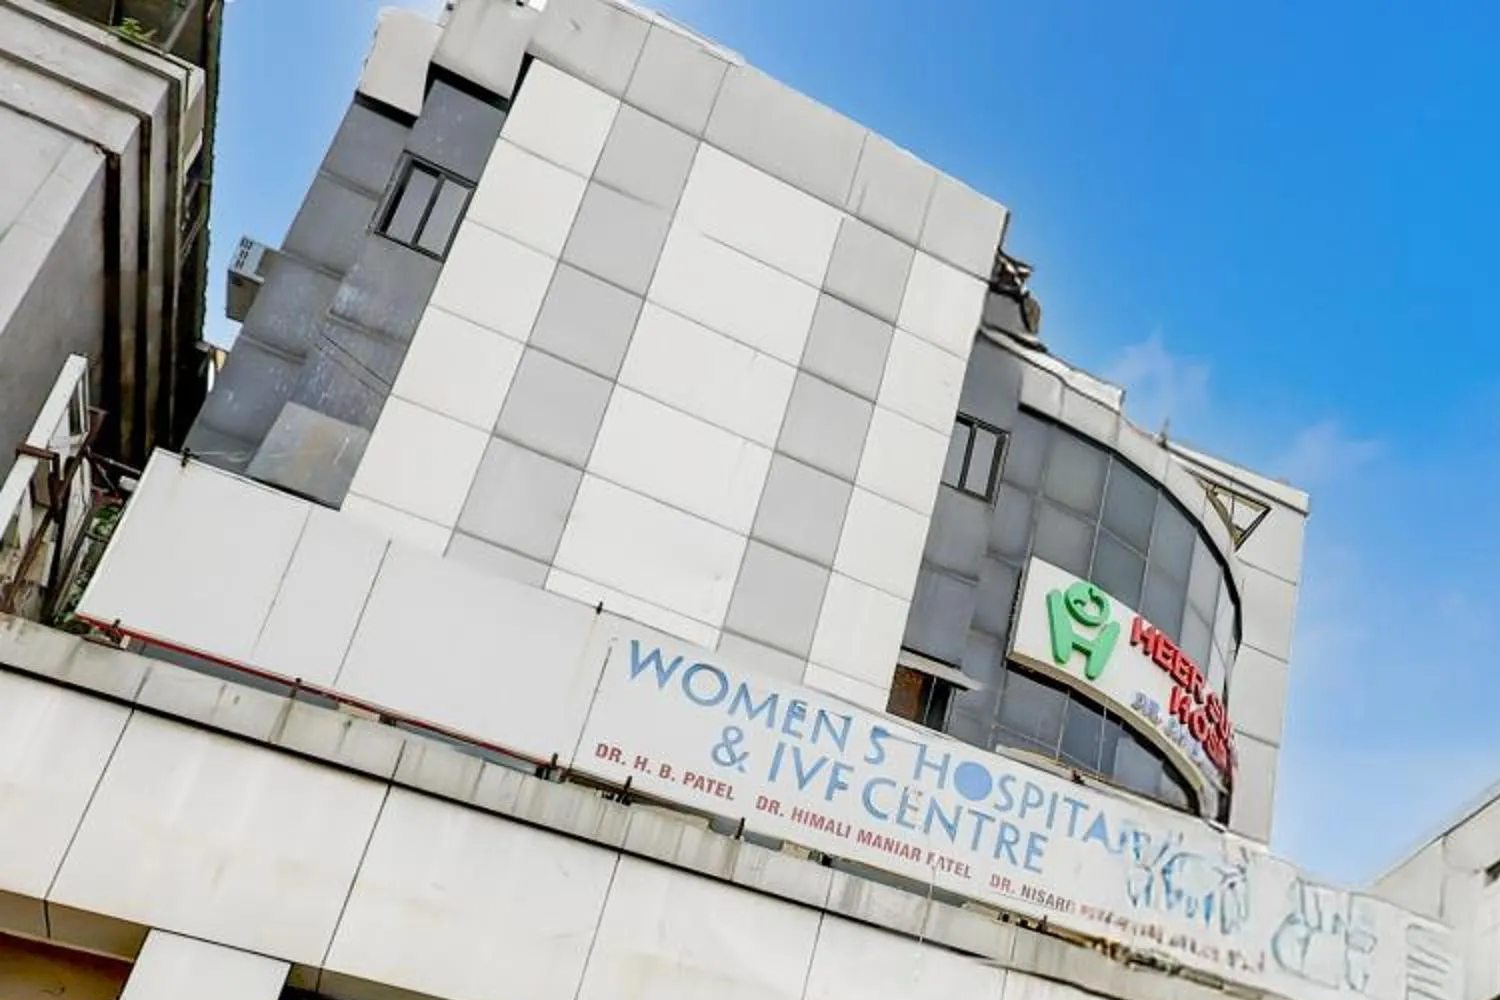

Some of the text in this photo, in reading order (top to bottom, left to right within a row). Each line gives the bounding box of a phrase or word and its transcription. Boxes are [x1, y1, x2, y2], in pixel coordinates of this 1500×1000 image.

[595, 743, 627, 766] DR.
[633, 755, 652, 774] H.
[659, 763, 677, 783] B.
[682, 771, 735, 801] PATEL
[755, 794, 785, 818] DR.
[790, 806, 850, 842] HIMALI
[856, 826, 922, 864] MANIAR
[989, 872, 1016, 894] DR.
[711, 726, 1049, 874] & IVF CENTRE
